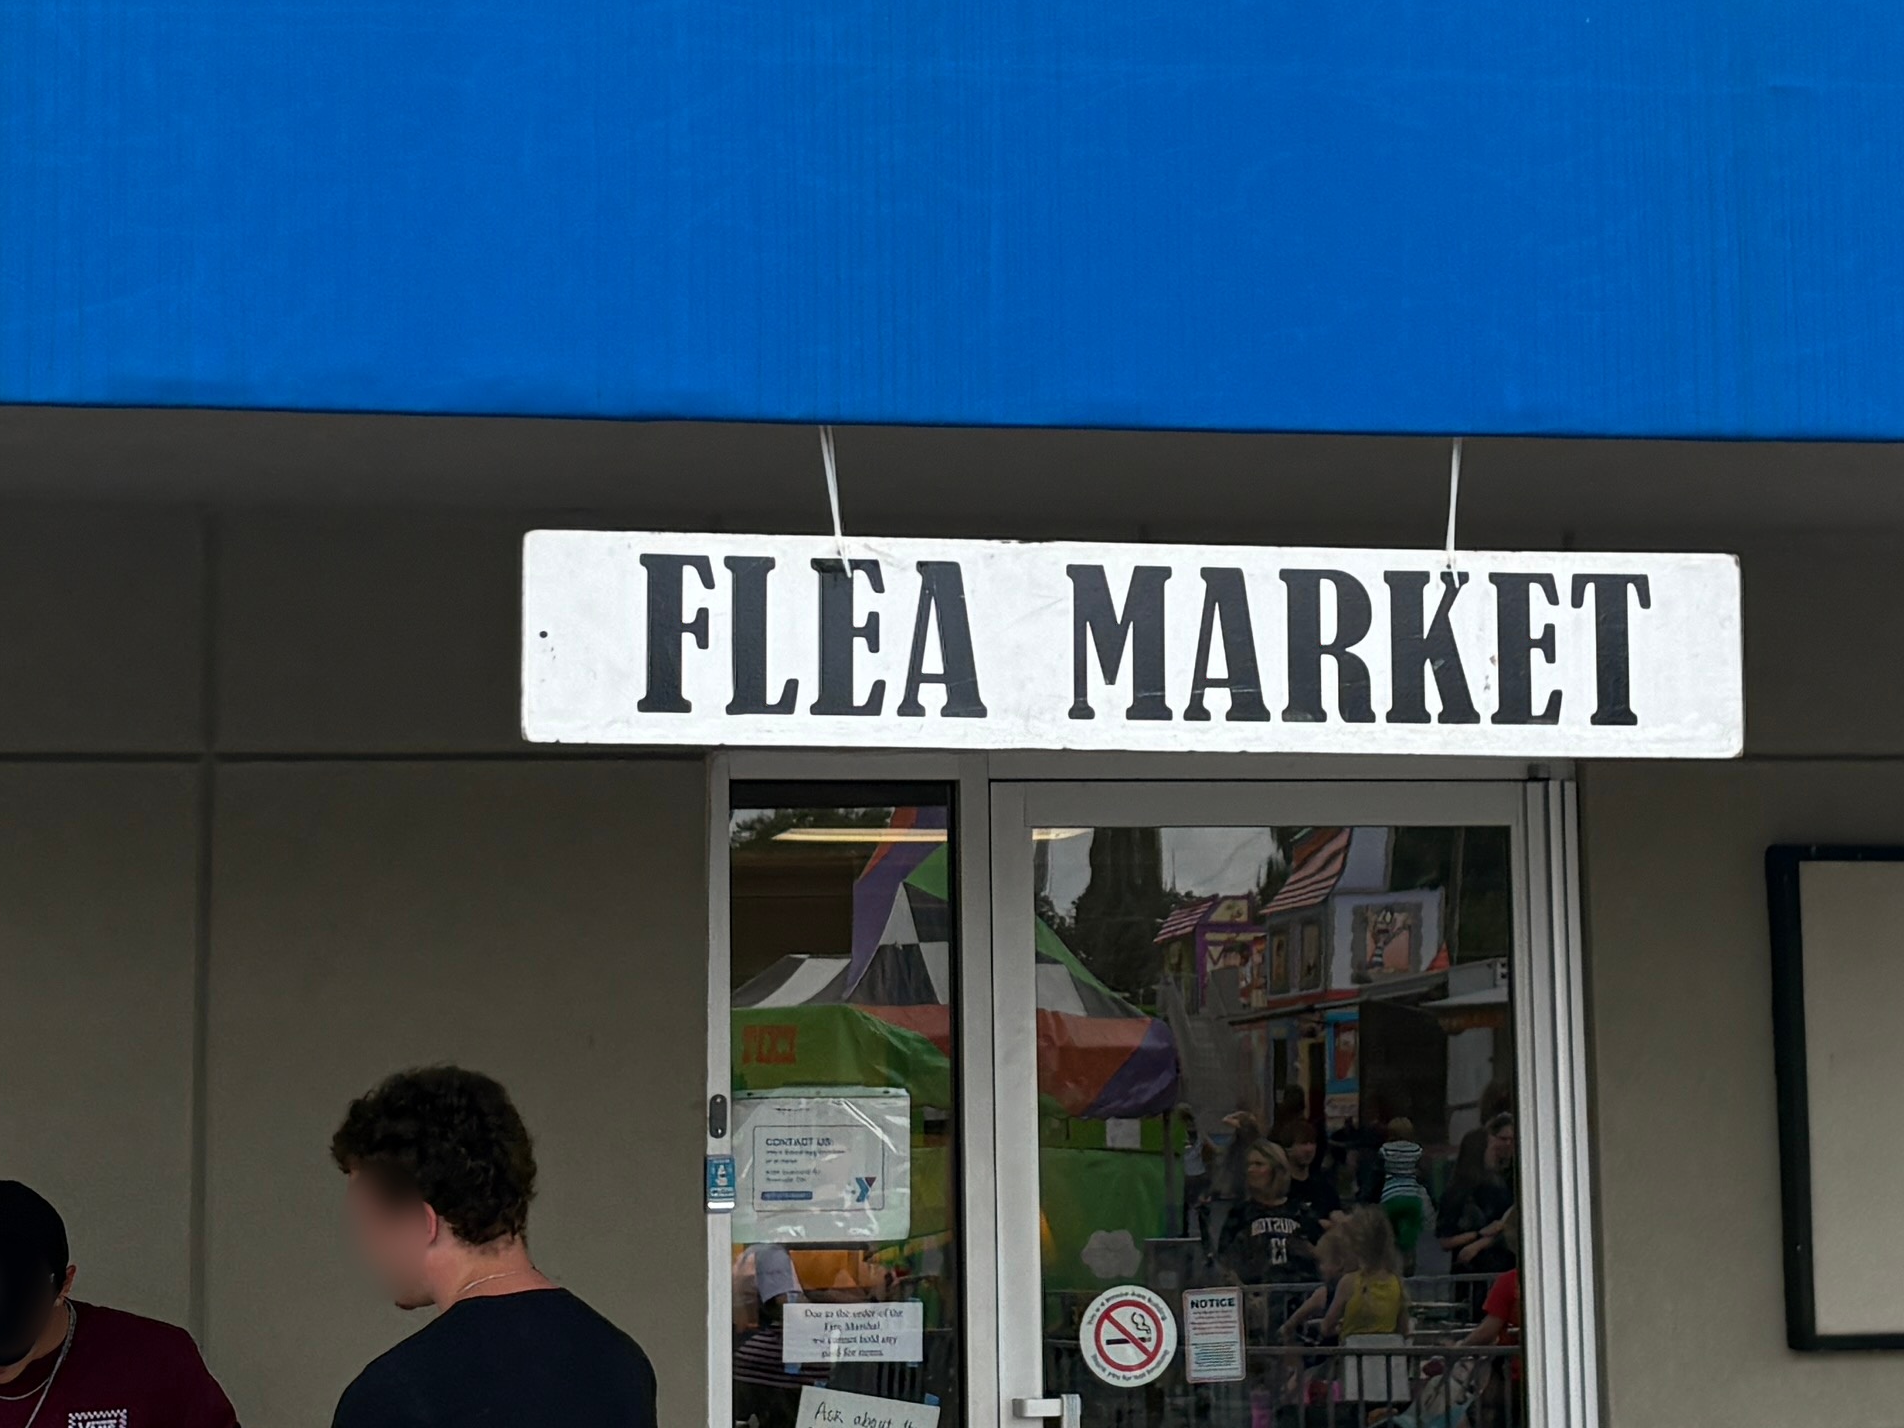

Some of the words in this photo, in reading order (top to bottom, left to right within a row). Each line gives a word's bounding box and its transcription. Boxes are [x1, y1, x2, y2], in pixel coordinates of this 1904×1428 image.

[637, 553, 988, 719] FLEA
[1066, 563, 1652, 726] MARKET
[766, 1137, 813, 1146] CONTACT
[1191, 1297, 1236, 1309] NOTICE
